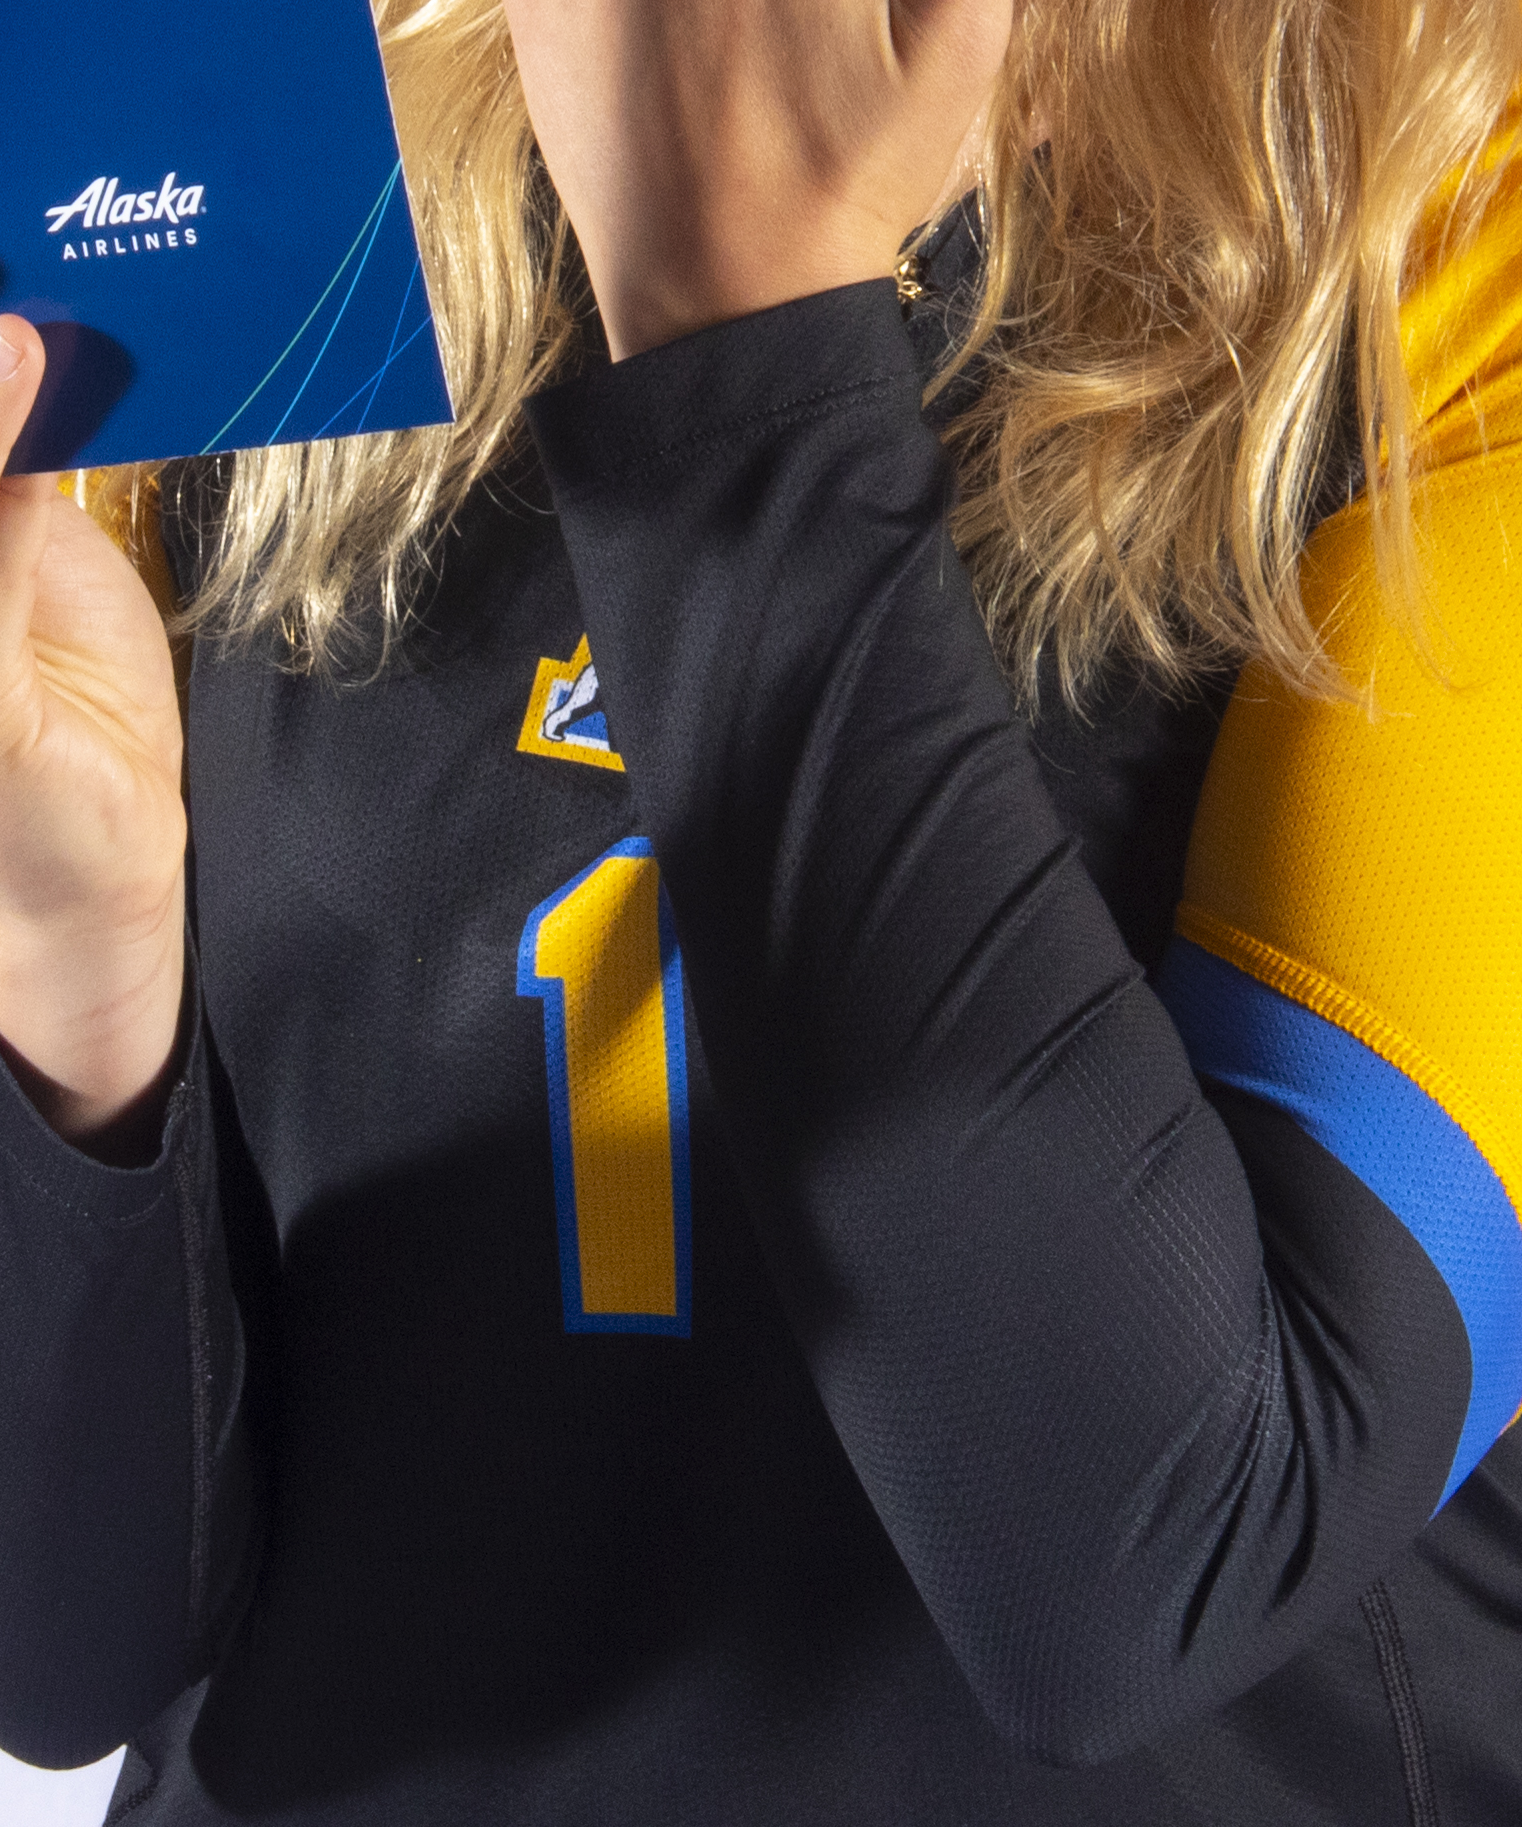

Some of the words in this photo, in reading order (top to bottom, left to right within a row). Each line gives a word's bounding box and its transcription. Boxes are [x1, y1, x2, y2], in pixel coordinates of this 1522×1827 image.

[45, 171, 205, 233] Alaska
[63, 228, 197, 261] AIRLINES
[515, 836, 692, 1338] 1
